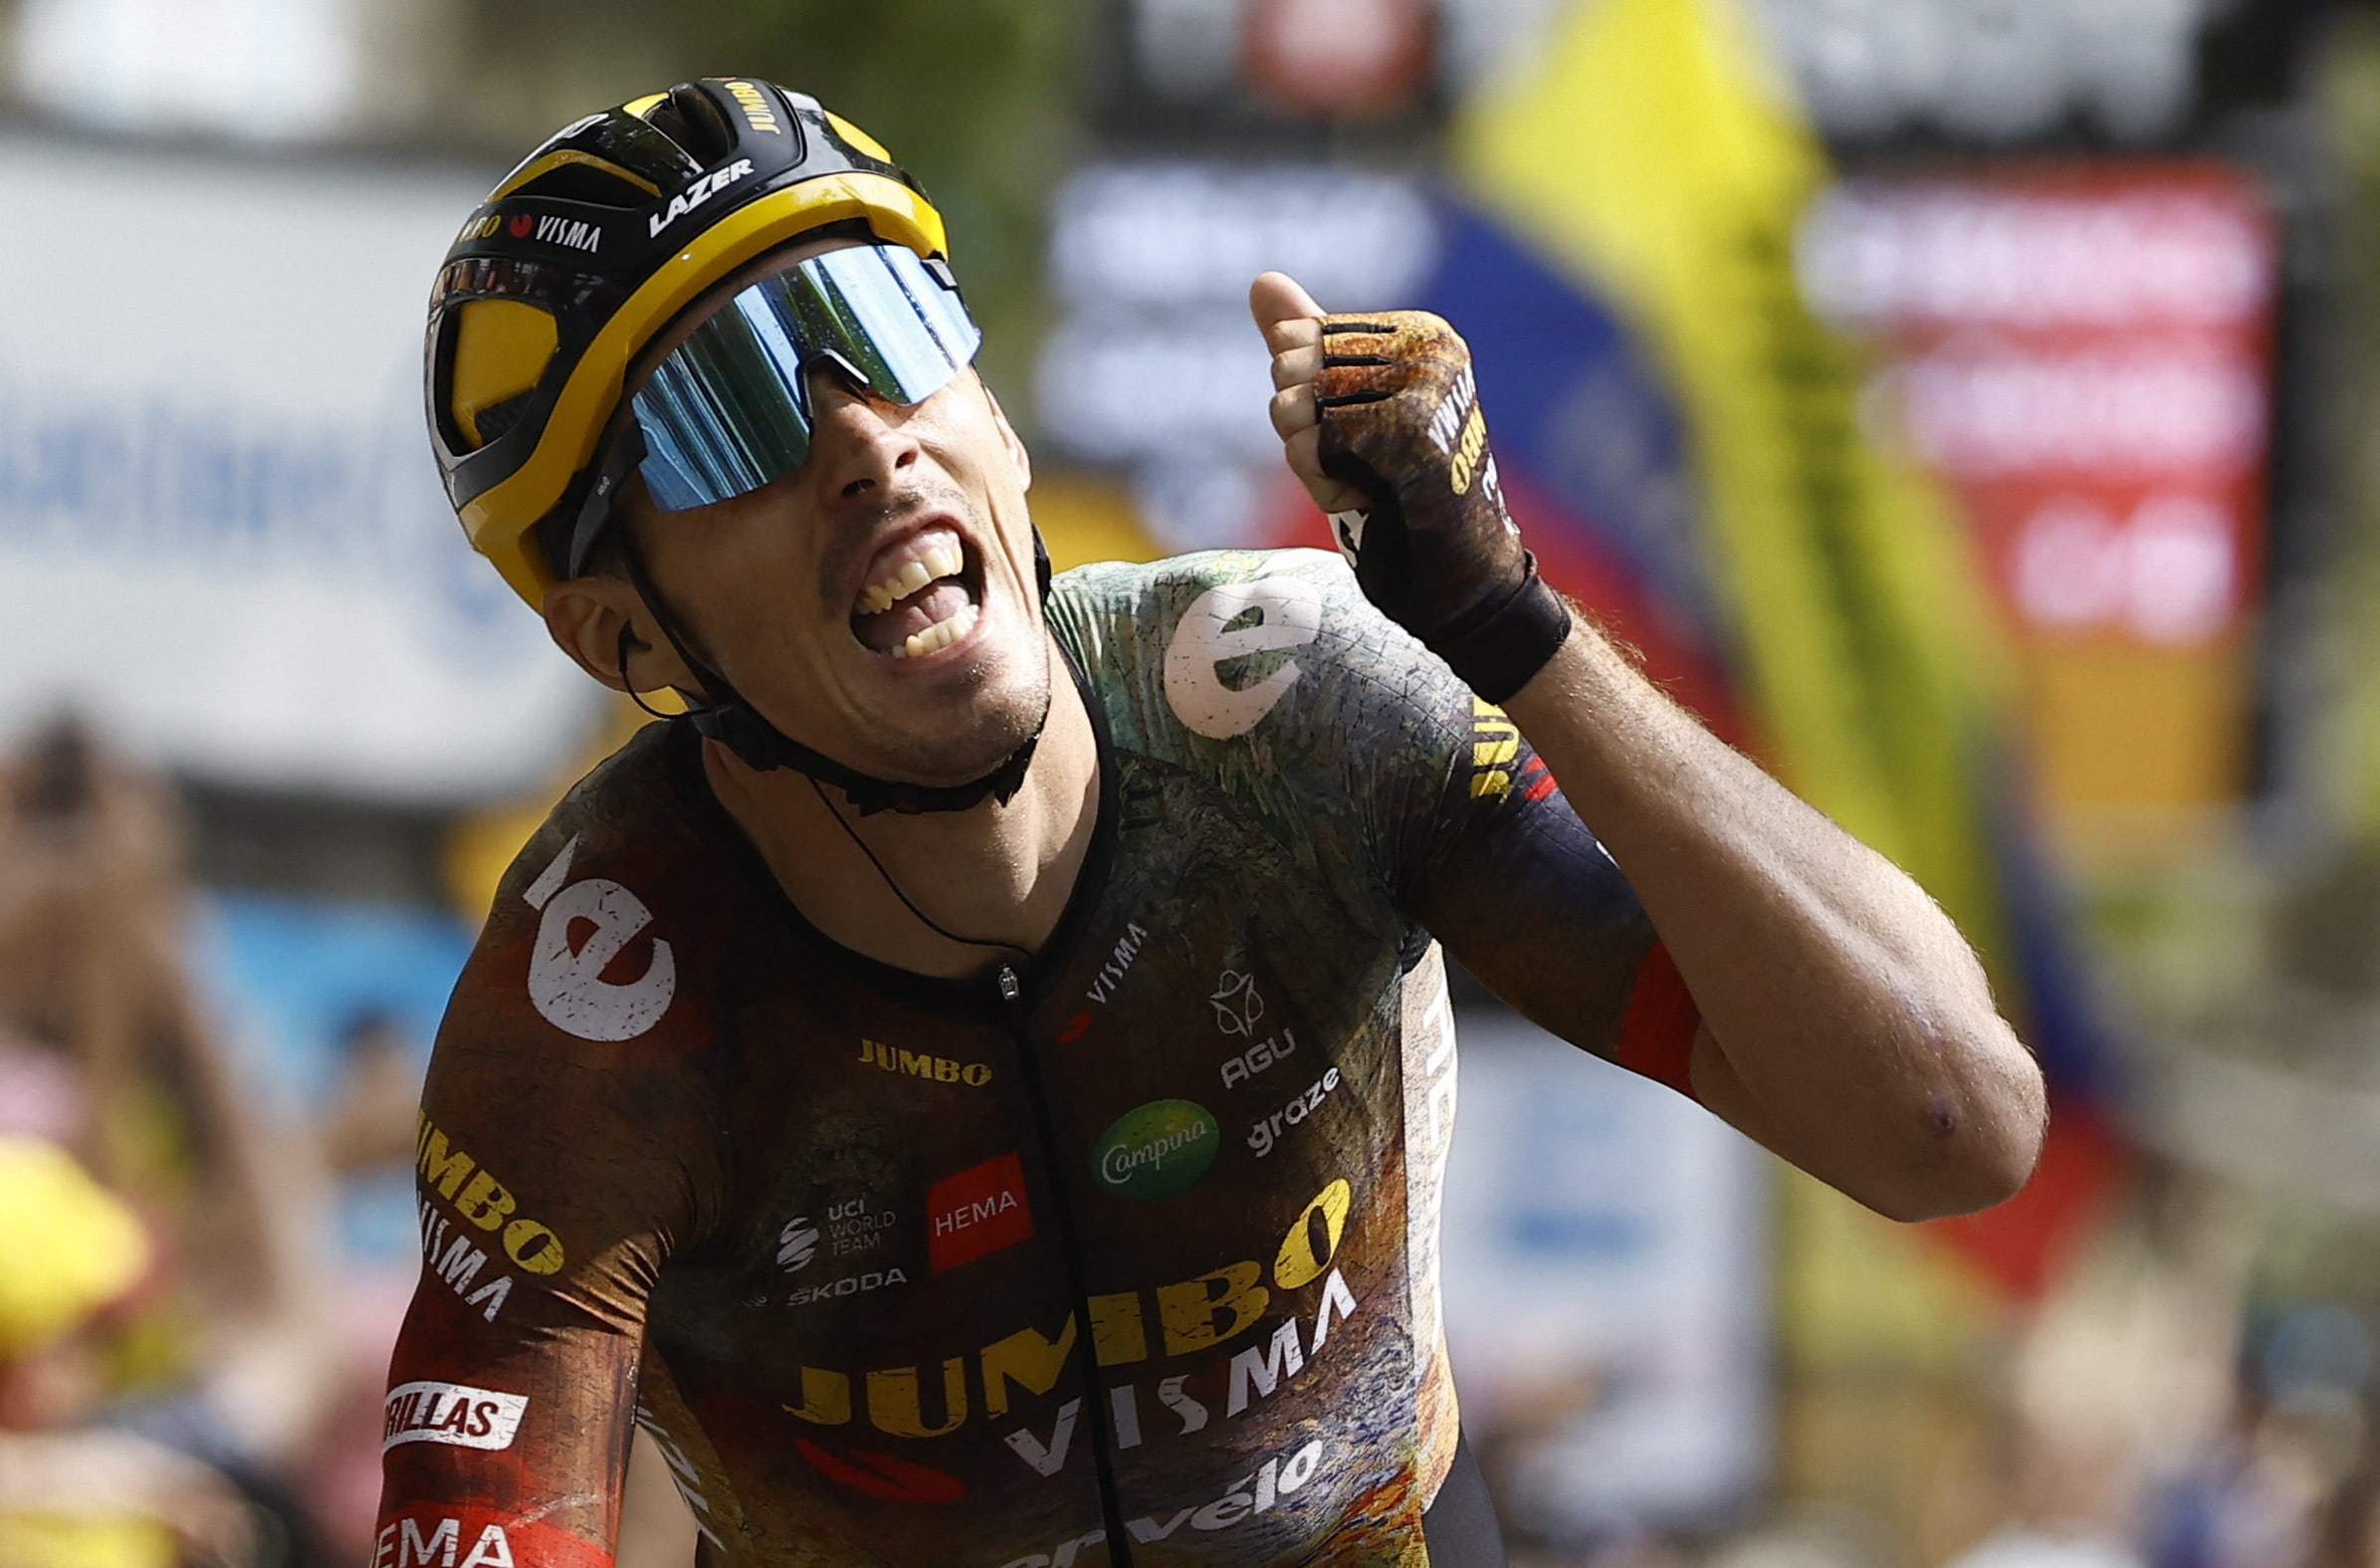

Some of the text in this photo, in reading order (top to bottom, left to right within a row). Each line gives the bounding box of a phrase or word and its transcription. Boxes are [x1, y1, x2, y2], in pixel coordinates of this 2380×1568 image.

[724, 82, 781, 135] JUMBO
[649, 158, 755, 239] LAZER
[536, 215, 601, 253] VISMA
[1086, 922, 1148, 1006] VISMA
[858, 1038, 993, 1086] JUMBO
[1220, 1027, 1297, 1090] AGU
[1246, 1066, 1341, 1158] graze
[1101, 1119, 1207, 1186] Campina
[828, 1199, 866, 1222] UCI
[829, 1211, 896, 1239] WORLD
[935, 1190, 1018, 1237] HEMA
[831, 1232, 881, 1256] TEAM
[781, 1179, 1352, 1438] JUMBO
[1003, 1266, 1358, 1478] VISMA
[370, 1517, 516, 1568] EMA
